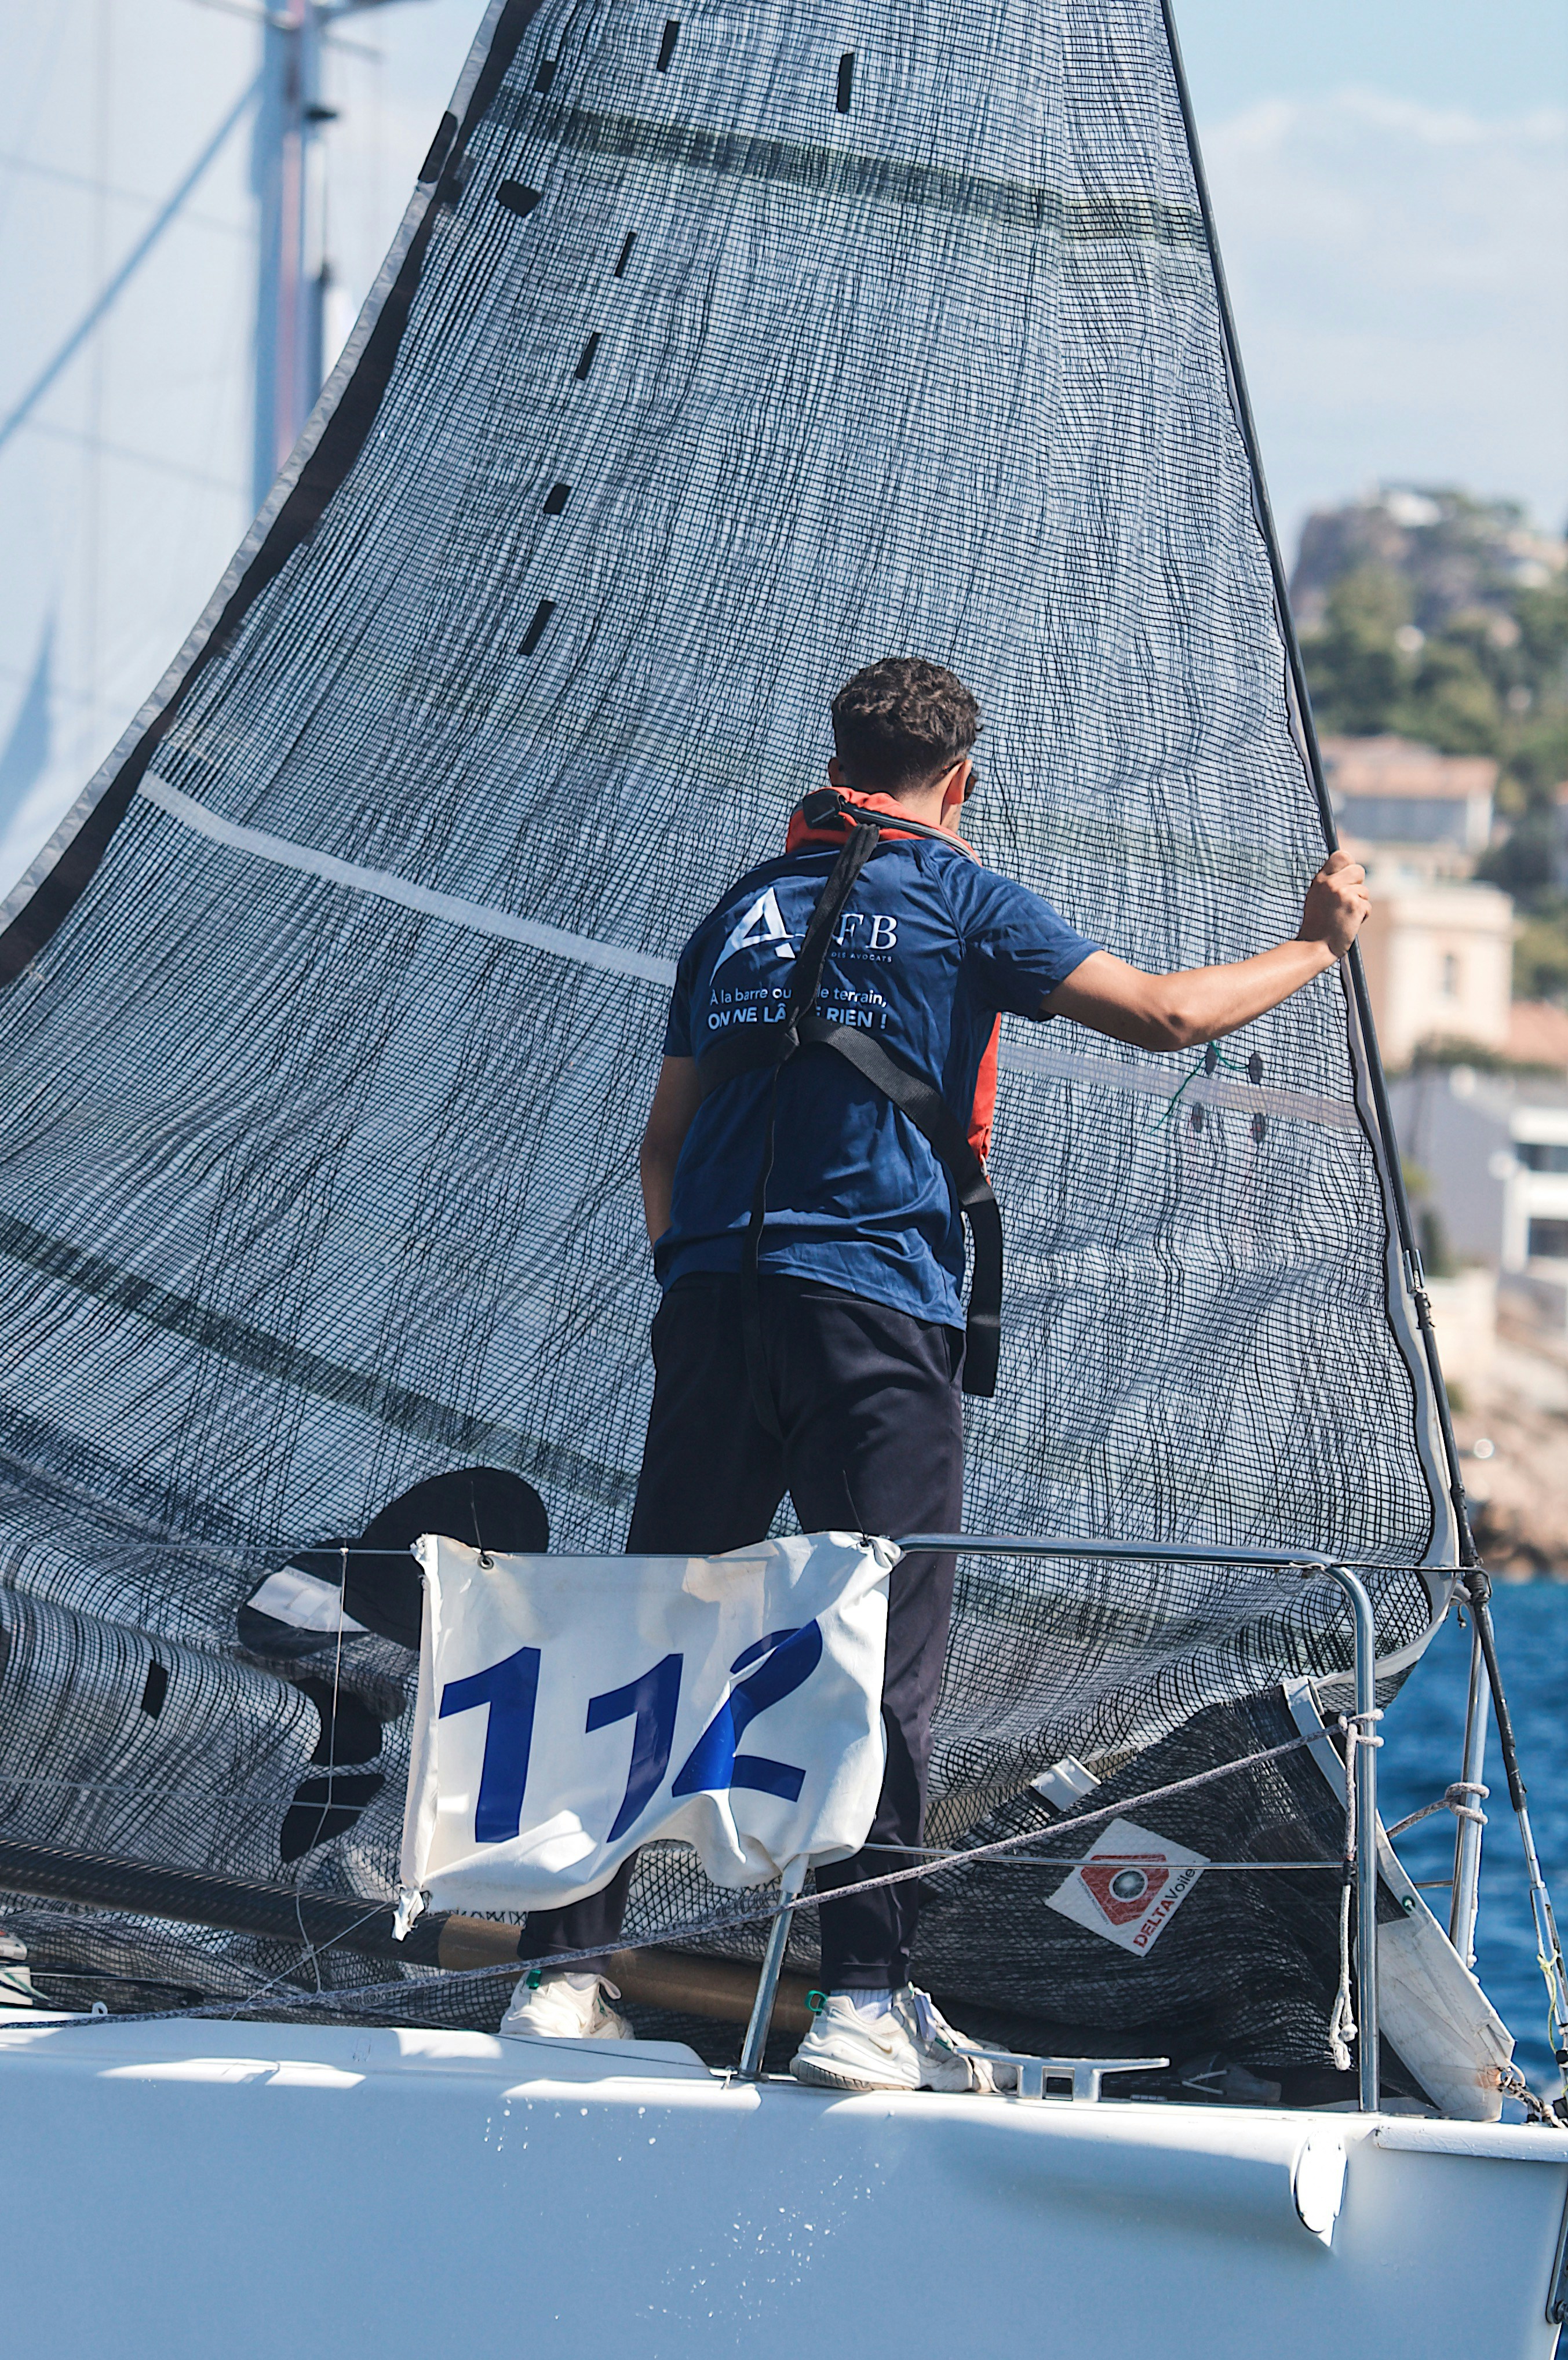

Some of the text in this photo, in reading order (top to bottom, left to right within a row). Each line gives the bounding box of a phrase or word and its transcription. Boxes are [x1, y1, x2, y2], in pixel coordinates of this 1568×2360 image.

[850, 953, 892, 962] AVOCATS
[710, 984, 887, 1008] À la barre ou le terrain,
[708, 1011, 731, 1030] ON
[733, 1006, 757, 1024] NE
[826, 1007, 873, 1028] RIEN
[880, 1013, 887, 1030] !
[439, 1618, 823, 1843] 112
[1133, 1861, 1196, 1948] DELTAVoile
